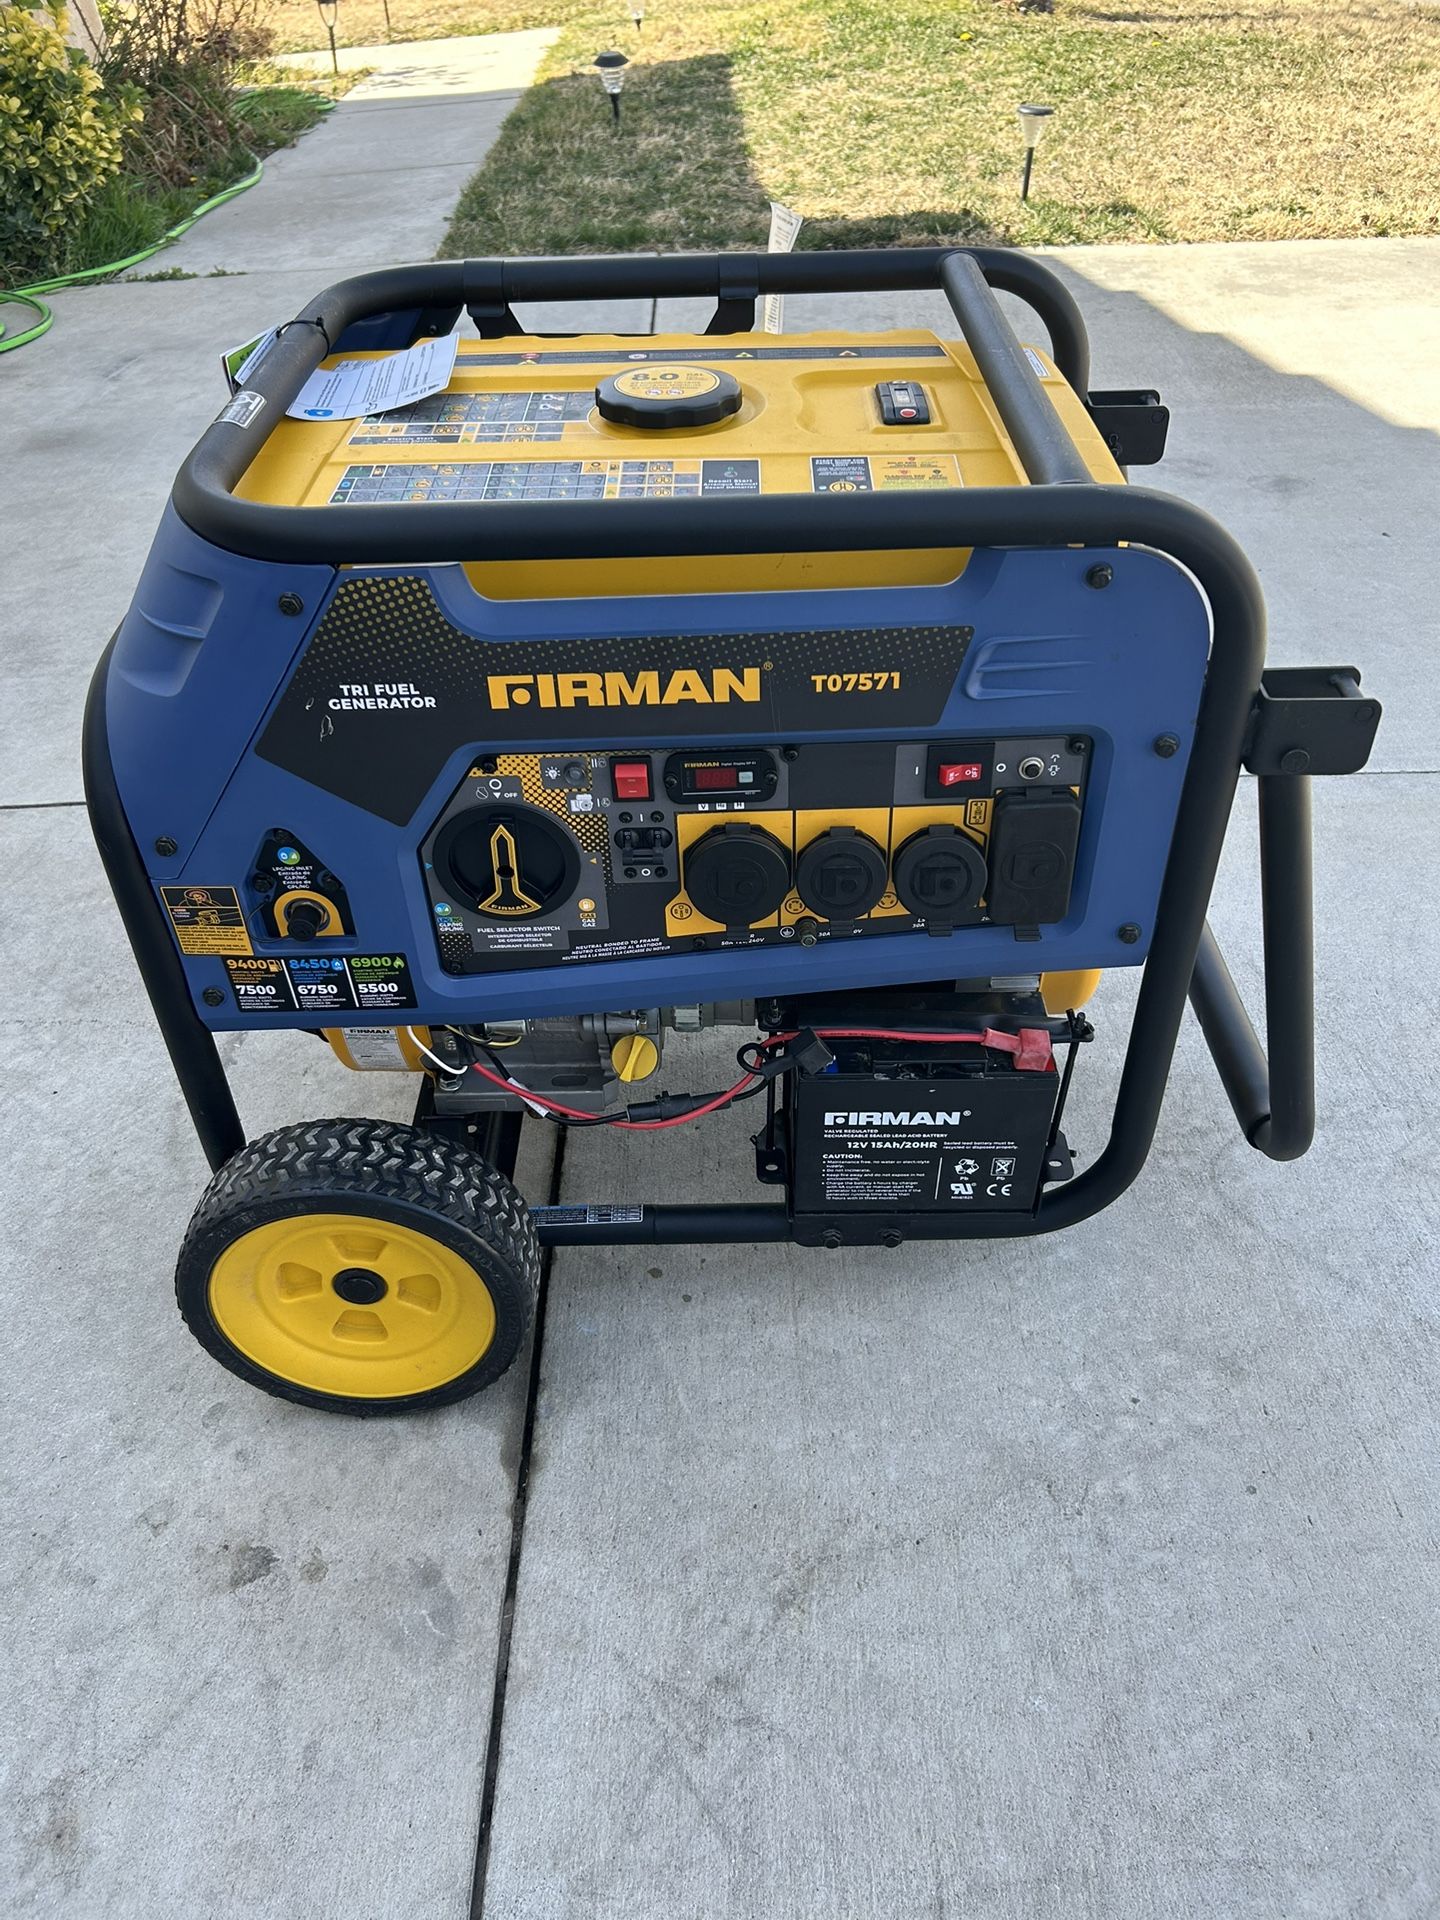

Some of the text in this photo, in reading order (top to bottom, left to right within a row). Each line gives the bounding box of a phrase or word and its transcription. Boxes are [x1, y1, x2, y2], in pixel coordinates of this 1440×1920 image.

[632, 373, 679, 381] 8.0
[811, 671, 900, 693] T07571
[339, 683, 420, 696] TRI FUEL
[329, 697, 437, 710] GENERATOR
[227, 956, 391, 969] 9400 8450 6900
[235, 983, 399, 995] 7500 6750 5500
[871, 1141, 938, 1149] 15Ah/20HR
